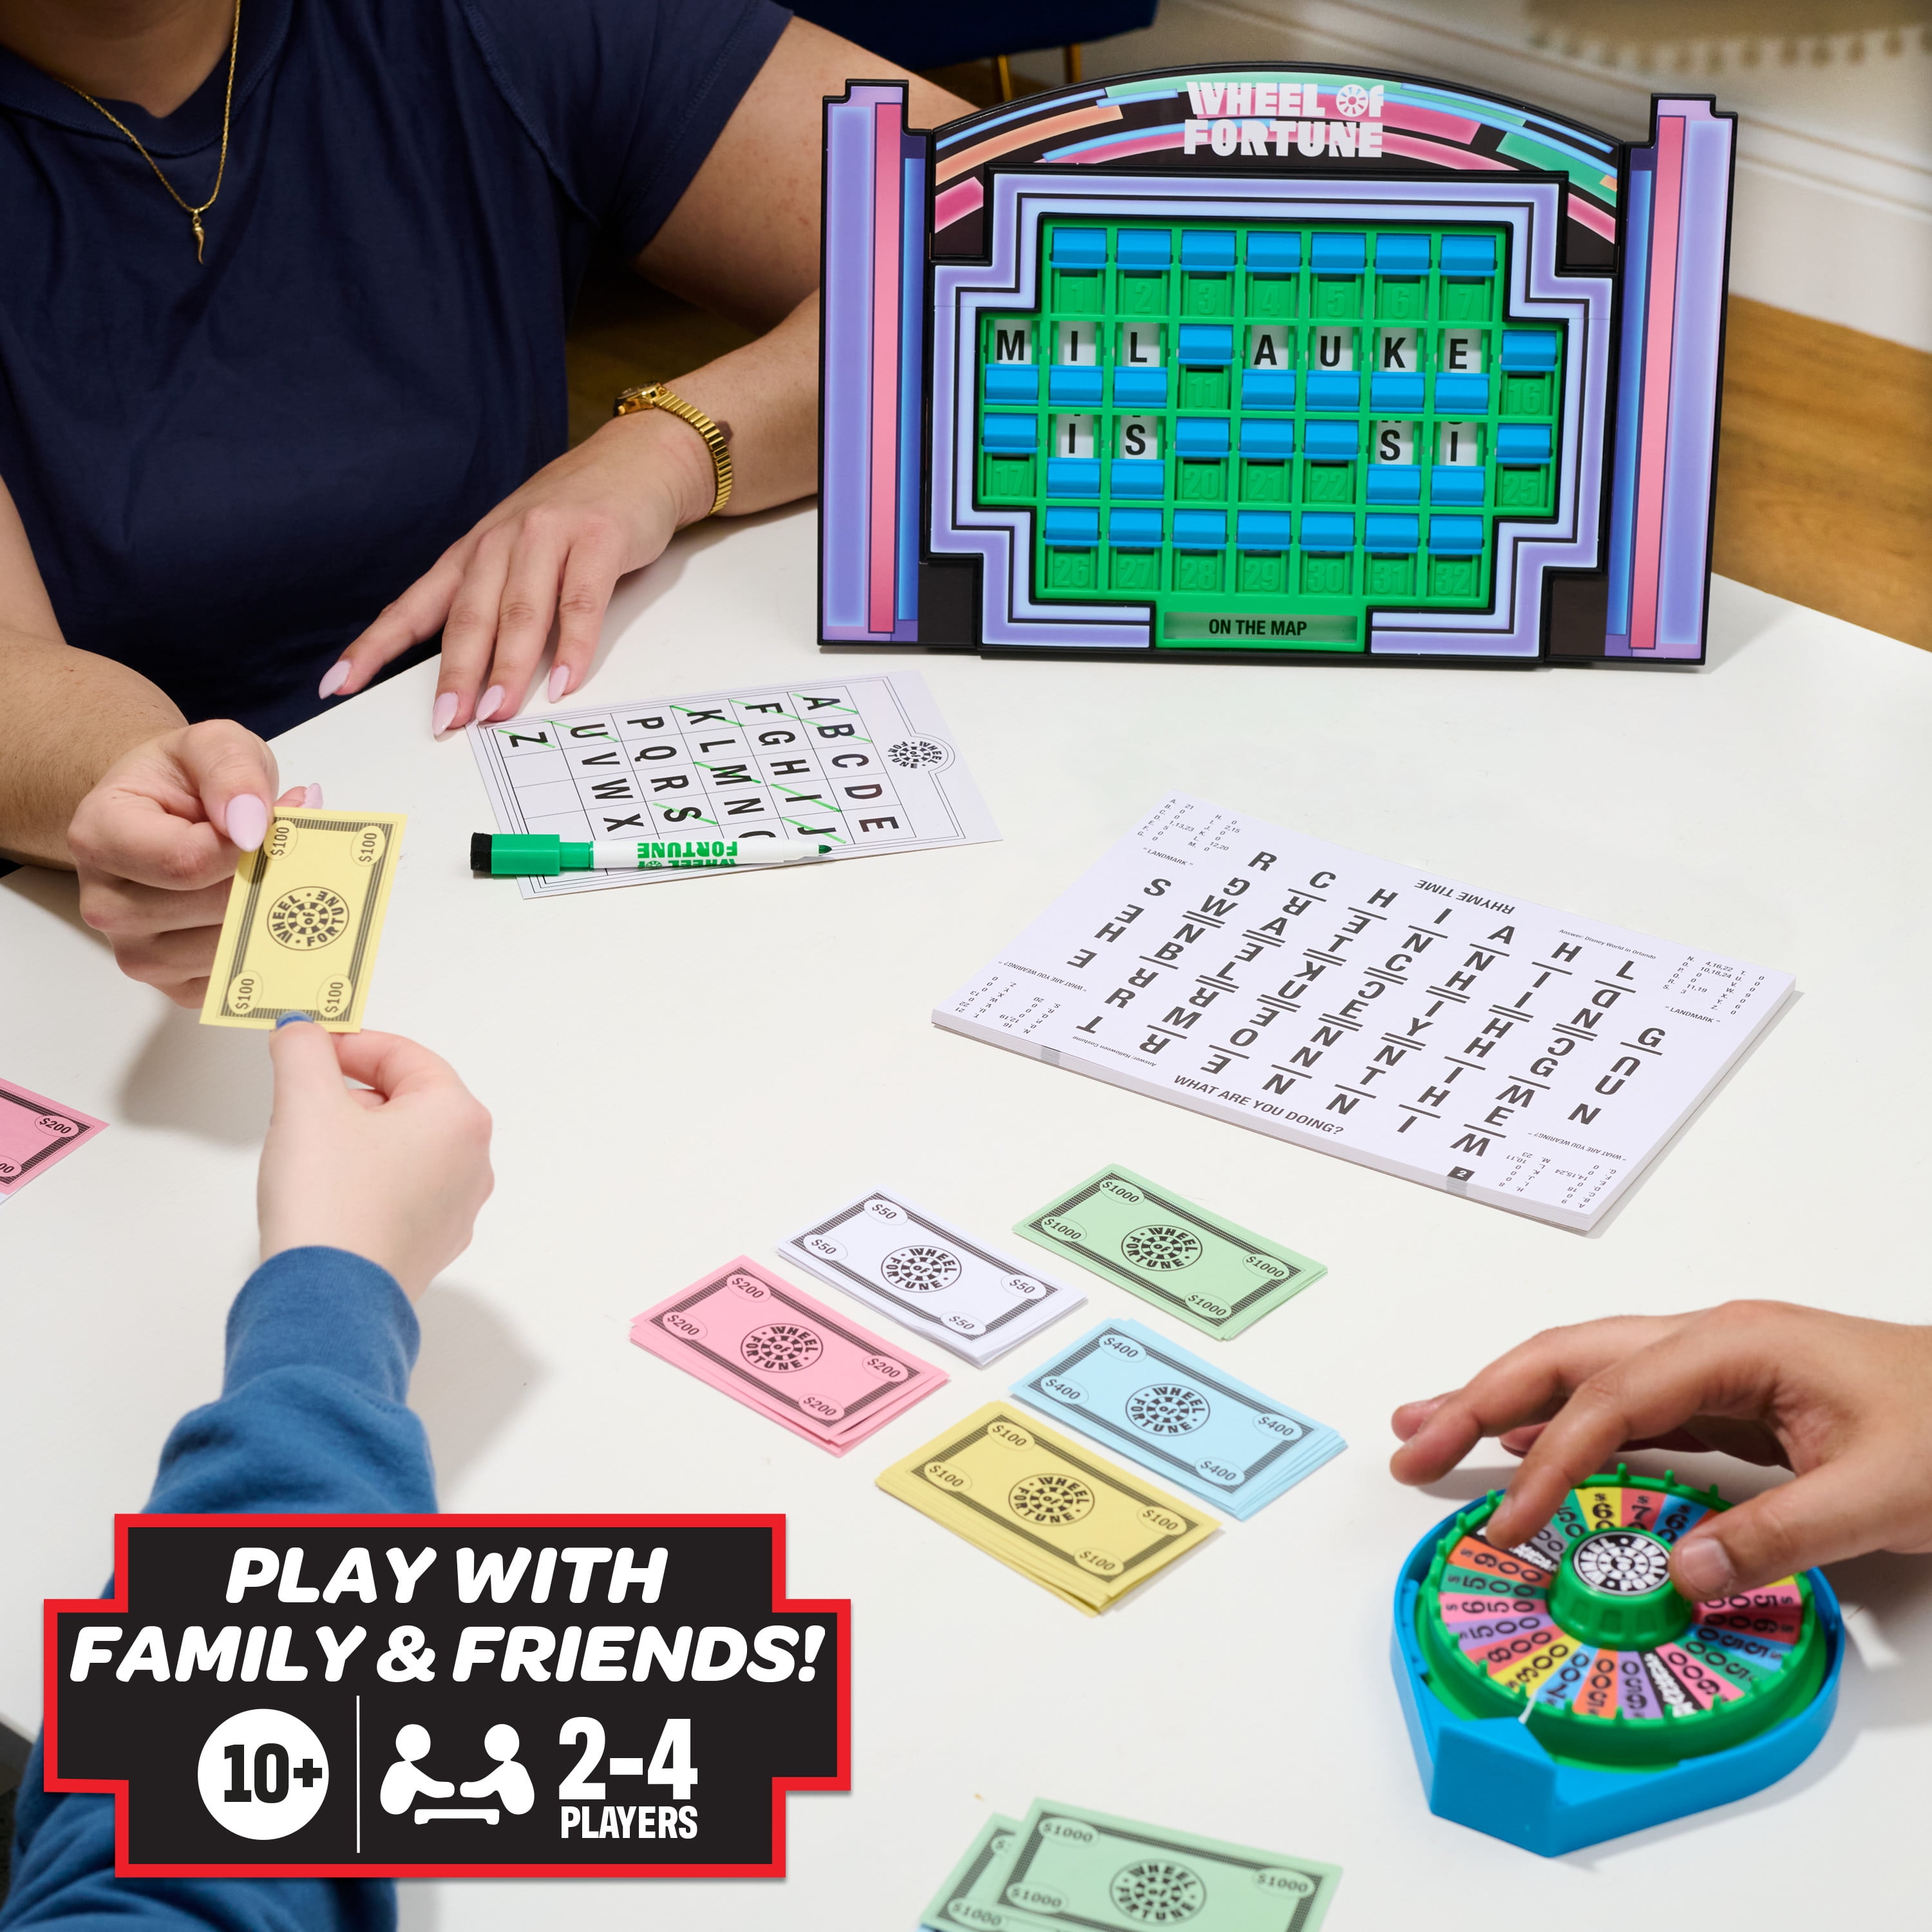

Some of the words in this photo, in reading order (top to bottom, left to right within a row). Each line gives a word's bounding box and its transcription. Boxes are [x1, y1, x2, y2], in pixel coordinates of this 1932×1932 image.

[1186, 82, 1325, 117] WHEEL
[1184, 118, 1383, 158] FORTUNE
[1209, 619, 1231, 634] ON
[1235, 620, 1265, 635] THE
[1271, 620, 1307, 636] MAP
[745, 703, 783, 713] F
[803, 697, 840, 710] A
[627, 717, 664, 728] P
[687, 710, 725, 724] K
[509, 732, 547, 747] Z
[571, 724, 608, 737] U
[759, 731, 795, 746] G
[817, 724, 855, 738] B
[635, 746, 676, 761] Q
[700, 740, 735, 752] L
[887, 741, 918, 768] FORTUNE
[919, 741, 942, 764] WHEEL
[582, 752, 620, 764] V
[770, 760, 810, 775] H
[832, 754, 869, 768] C
[651, 775, 688, 791] R
[710, 764, 752, 785] M
[592, 779, 633, 799] W
[845, 784, 882, 799] D
[664, 808, 701, 822] S
[724, 799, 764, 815] N
[603, 814, 644, 831] X
[859, 817, 898, 832] E
[270, 826, 289, 856] $100
[358, 832, 377, 862] $100
[638, 841, 737, 858] FORTUNE
[1414, 879, 1454, 898] TIME
[1456, 891, 1515, 914] RHYME
[272, 895, 301, 943] WHEEL
[306, 890, 345, 947] FORTUNE
[1248, 852, 1276, 871] R
[1310, 872, 1336, 888] C
[1367, 889, 1397, 907] H
[1434, 909, 1452, 924] I
[1488, 926, 1515, 944] A
[1551, 942, 1582, 962] H
[1616, 961, 1634, 980] L
[1559, 929, 1584, 939] Answer:
[1584, 936, 1605, 945] Disney
[1632, 950, 1656, 960] Orlando
[1144, 879, 1171, 896] S
[1200, 895, 1238, 916] W
[1260, 917, 1287, 936] A
[1328, 934, 1353, 952] T
[1386, 954, 1412, 971] C
[1445, 971, 1476, 991] H
[1514, 992, 1533, 1008] I
[1571, 1009, 1603, 1028] N
[1638, 1028, 1665, 1047] G
[235, 978, 254, 1010] $100
[325, 981, 343, 1013] $100
[1173, 1075, 1219, 1094] WHAT
[1218, 1090, 1251, 1105] ARE
[1254, 1100, 1284, 1115] YOU
[1285, 1111, 1344, 1135] DOING?
[39, 1117, 72, 1134] $200
[1102, 1180, 1140, 1204] $1000
[871, 1202, 897, 1220] $50
[1043, 1217, 1082, 1241] $1000
[1148, 1227, 1198, 1252] WHEEL
[810, 1238, 837, 1255] $50
[1126, 1236, 1185, 1269] FORTUNE
[1245, 1255, 1285, 1278] $1000
[731, 1276, 764, 1300] $200
[1009, 1278, 1036, 1295] $50
[1188, 1294, 1227, 1318] $1000
[667, 1314, 700, 1337] $200
[948, 1315, 975, 1331] $50
[1103, 1335, 1139, 1359] $400
[867, 1358, 901, 1379] $200
[1045, 1378, 1081, 1402] $400
[802, 1396, 837, 1418] $200
[992, 1423, 1027, 1447] $100
[1257, 1415, 1294, 1437] $400
[929, 1464, 964, 1487] $100
[1200, 1459, 1236, 1482] $400
[1142, 1509, 1178, 1531] $100
[1079, 1549, 1115, 1572] $100
